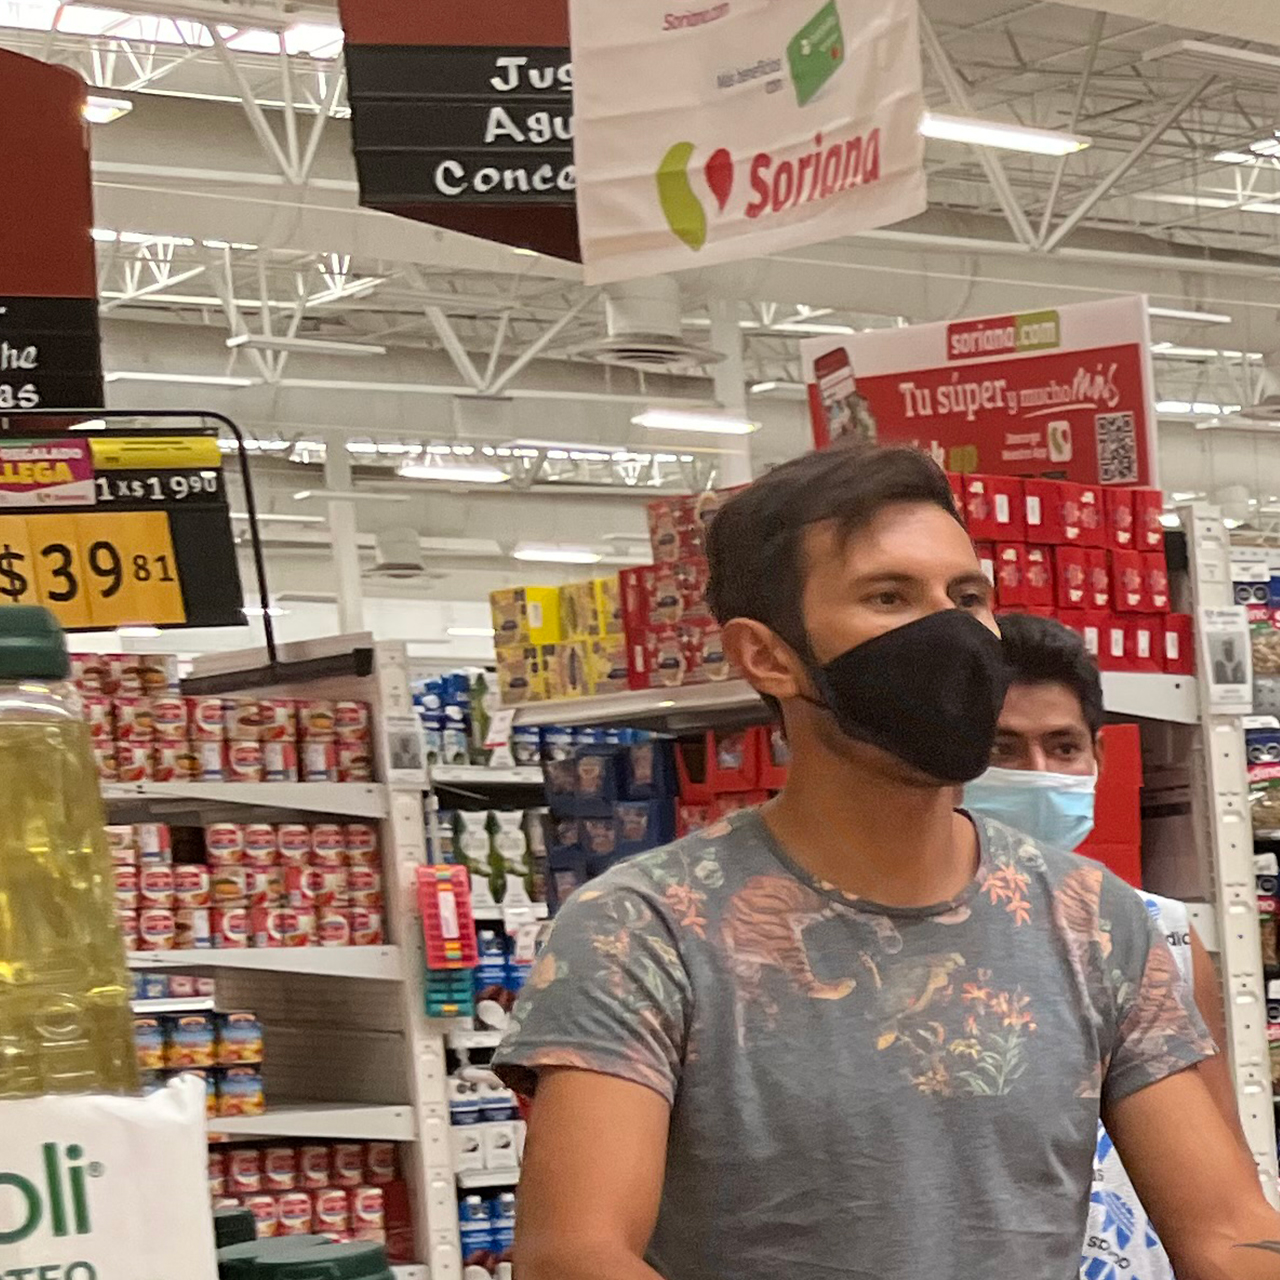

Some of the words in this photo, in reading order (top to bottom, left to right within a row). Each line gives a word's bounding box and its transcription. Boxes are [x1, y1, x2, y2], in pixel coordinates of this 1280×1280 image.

[745, 127, 881, 219] Soriana
[898, 382, 933, 417] Tu
[936, 372, 1006, 421] súper
[133, 554, 174, 583] 81
